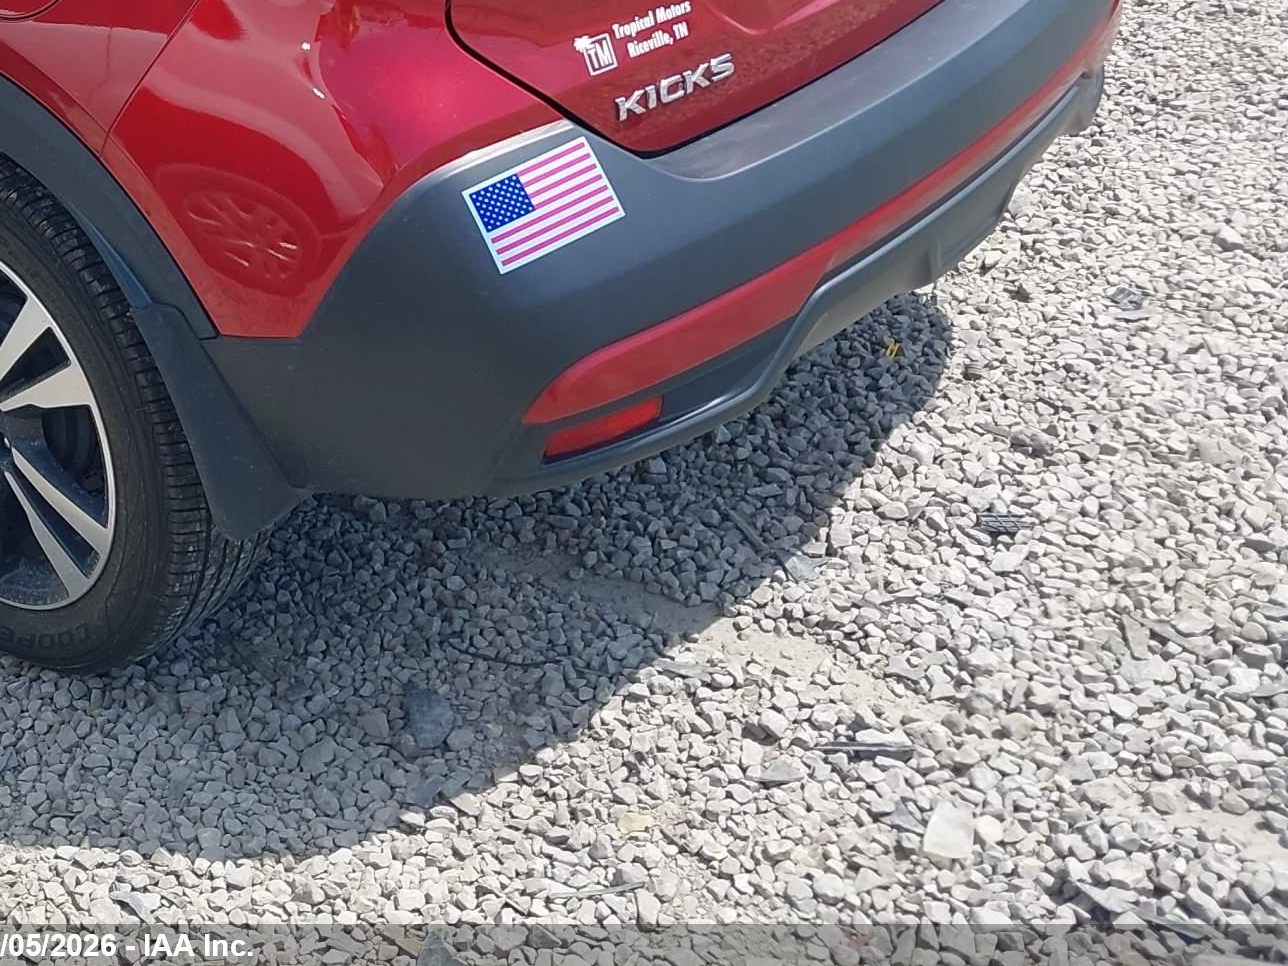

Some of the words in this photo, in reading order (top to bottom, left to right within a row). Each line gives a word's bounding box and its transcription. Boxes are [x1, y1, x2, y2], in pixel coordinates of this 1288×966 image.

[612, 10, 655, 40] Tropical
[655, 0, 692, 24] Motors
[588, 40, 612, 69] TM
[627, 29, 674, 58] Riceville,
[673, 21, 689, 40] TN
[615, 53, 735, 122] KICKS
